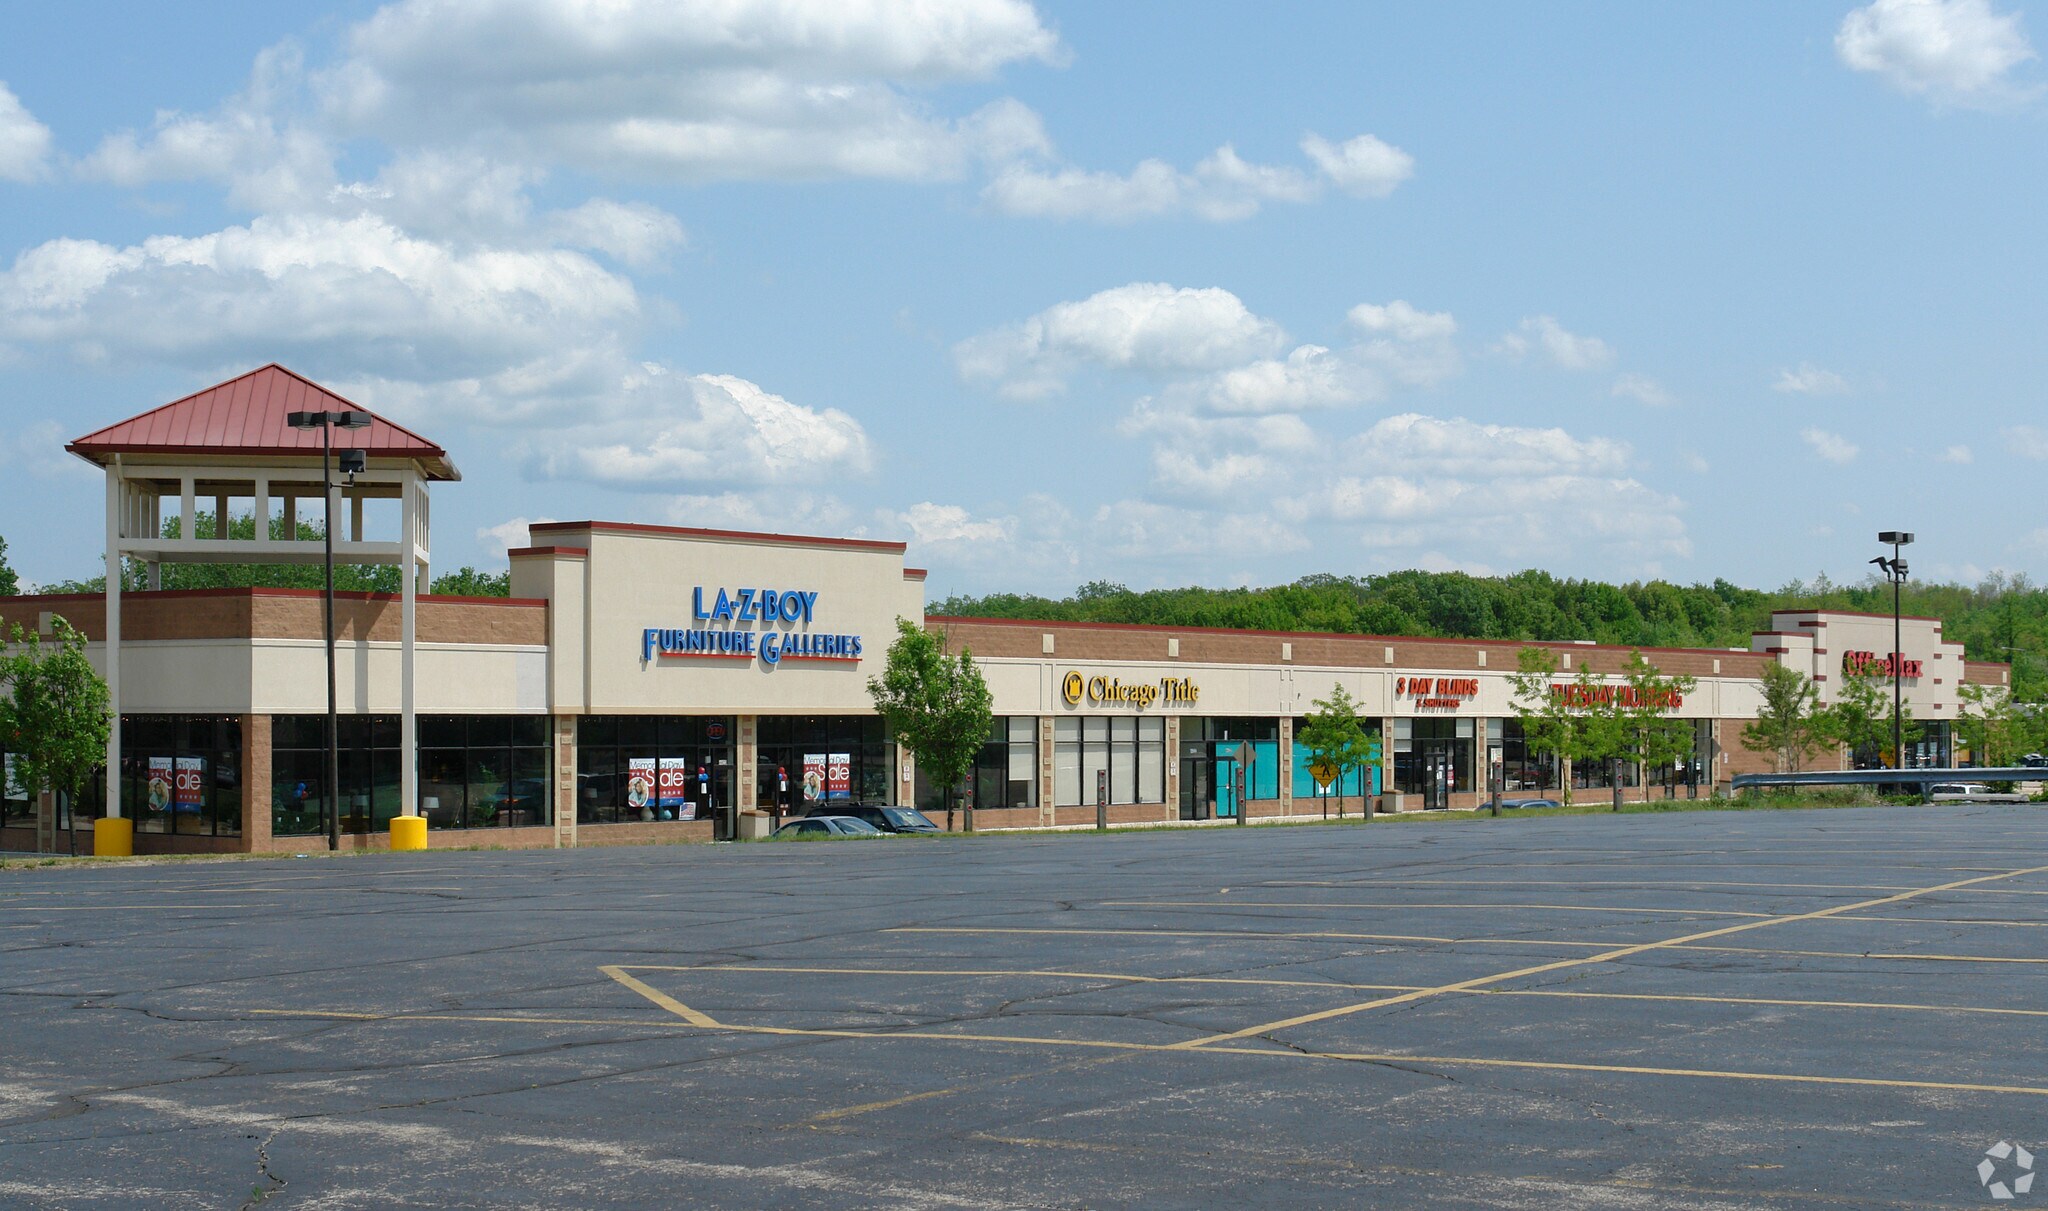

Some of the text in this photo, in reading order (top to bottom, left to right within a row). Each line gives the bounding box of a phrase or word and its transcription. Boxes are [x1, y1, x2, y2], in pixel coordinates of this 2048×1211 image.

[693, 586, 818, 623] LA-Z-BOY
[643, 628, 863, 665] FURNITURE GALLERIES
[1843, 650, 1923, 677] OffceMax
[1088, 676, 1200, 707] Chicago Title
[1396, 677, 1479, 696] 3 DAY BLINDS
[1549, 683, 1683, 709] TUESDAY MONING
[1424, 699, 1461, 708] SHUTTERS
[165, 769, 201, 791] Sale
[646, 768, 684, 787] Sale
[818, 763, 850, 781] Sale
